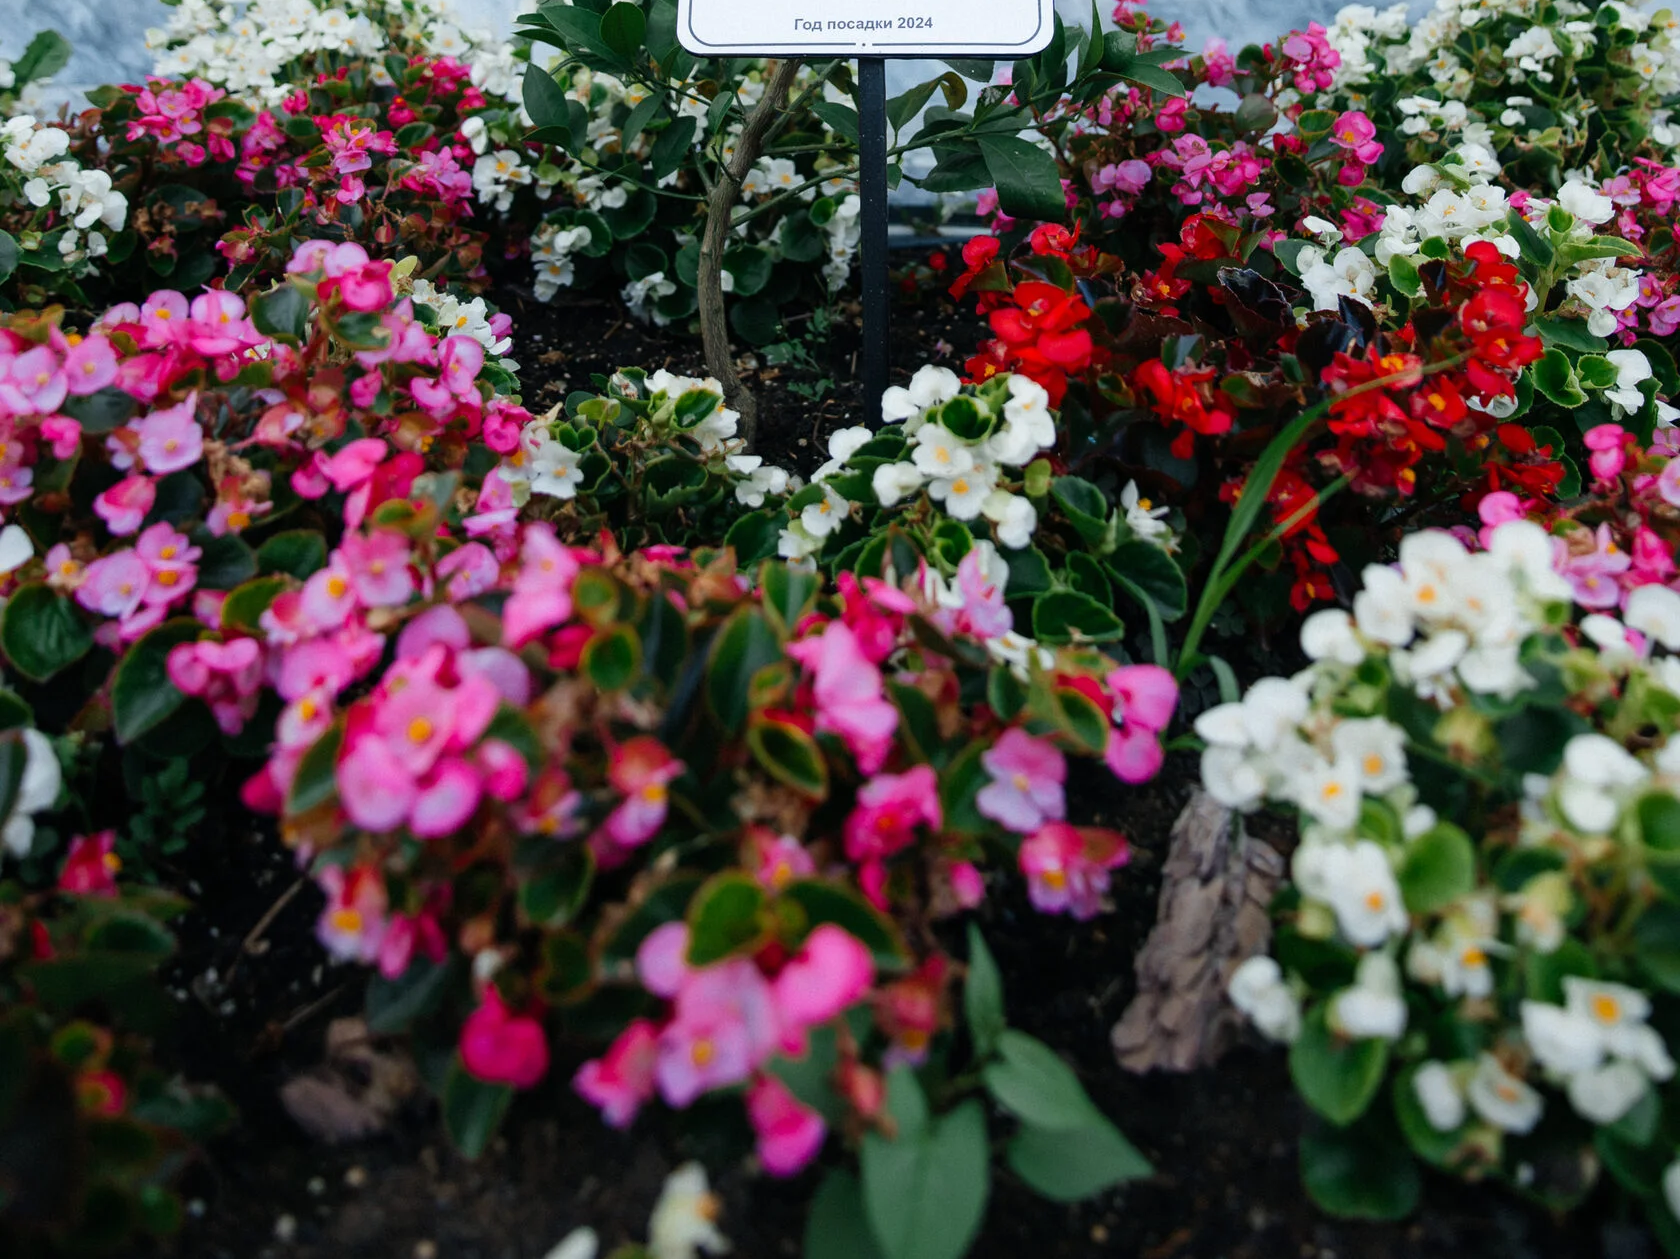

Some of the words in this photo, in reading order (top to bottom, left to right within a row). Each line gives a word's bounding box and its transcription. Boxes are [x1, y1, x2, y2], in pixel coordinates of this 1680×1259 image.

[794, 18, 823, 32] Год
[827, 19, 893, 31] посадки
[897, 17, 934, 29] 2024
